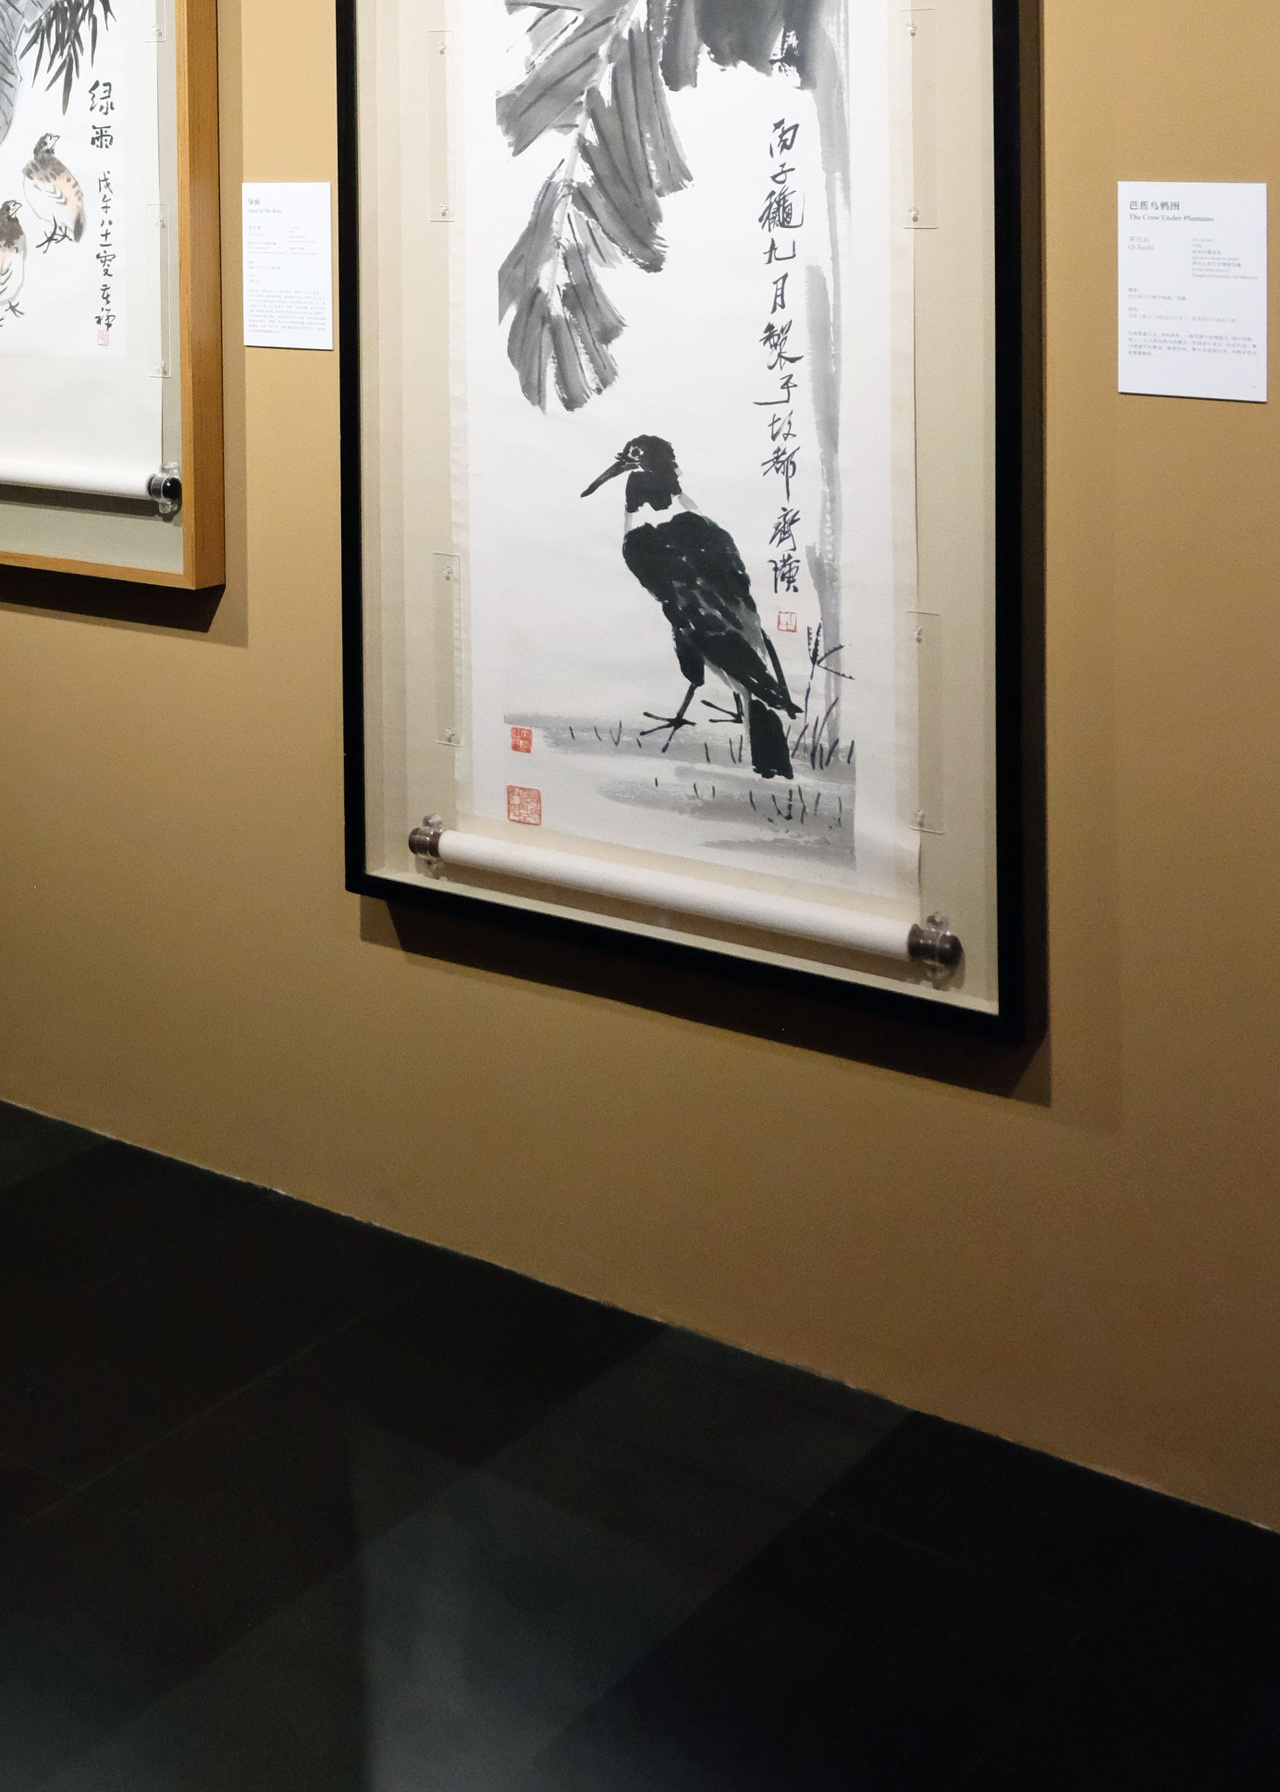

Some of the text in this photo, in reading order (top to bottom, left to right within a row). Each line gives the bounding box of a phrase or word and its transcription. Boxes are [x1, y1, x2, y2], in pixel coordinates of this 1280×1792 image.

[1129, 200, 1180, 211] 芭蕉乌鸦图
[1129, 213, 1141, 221] The
